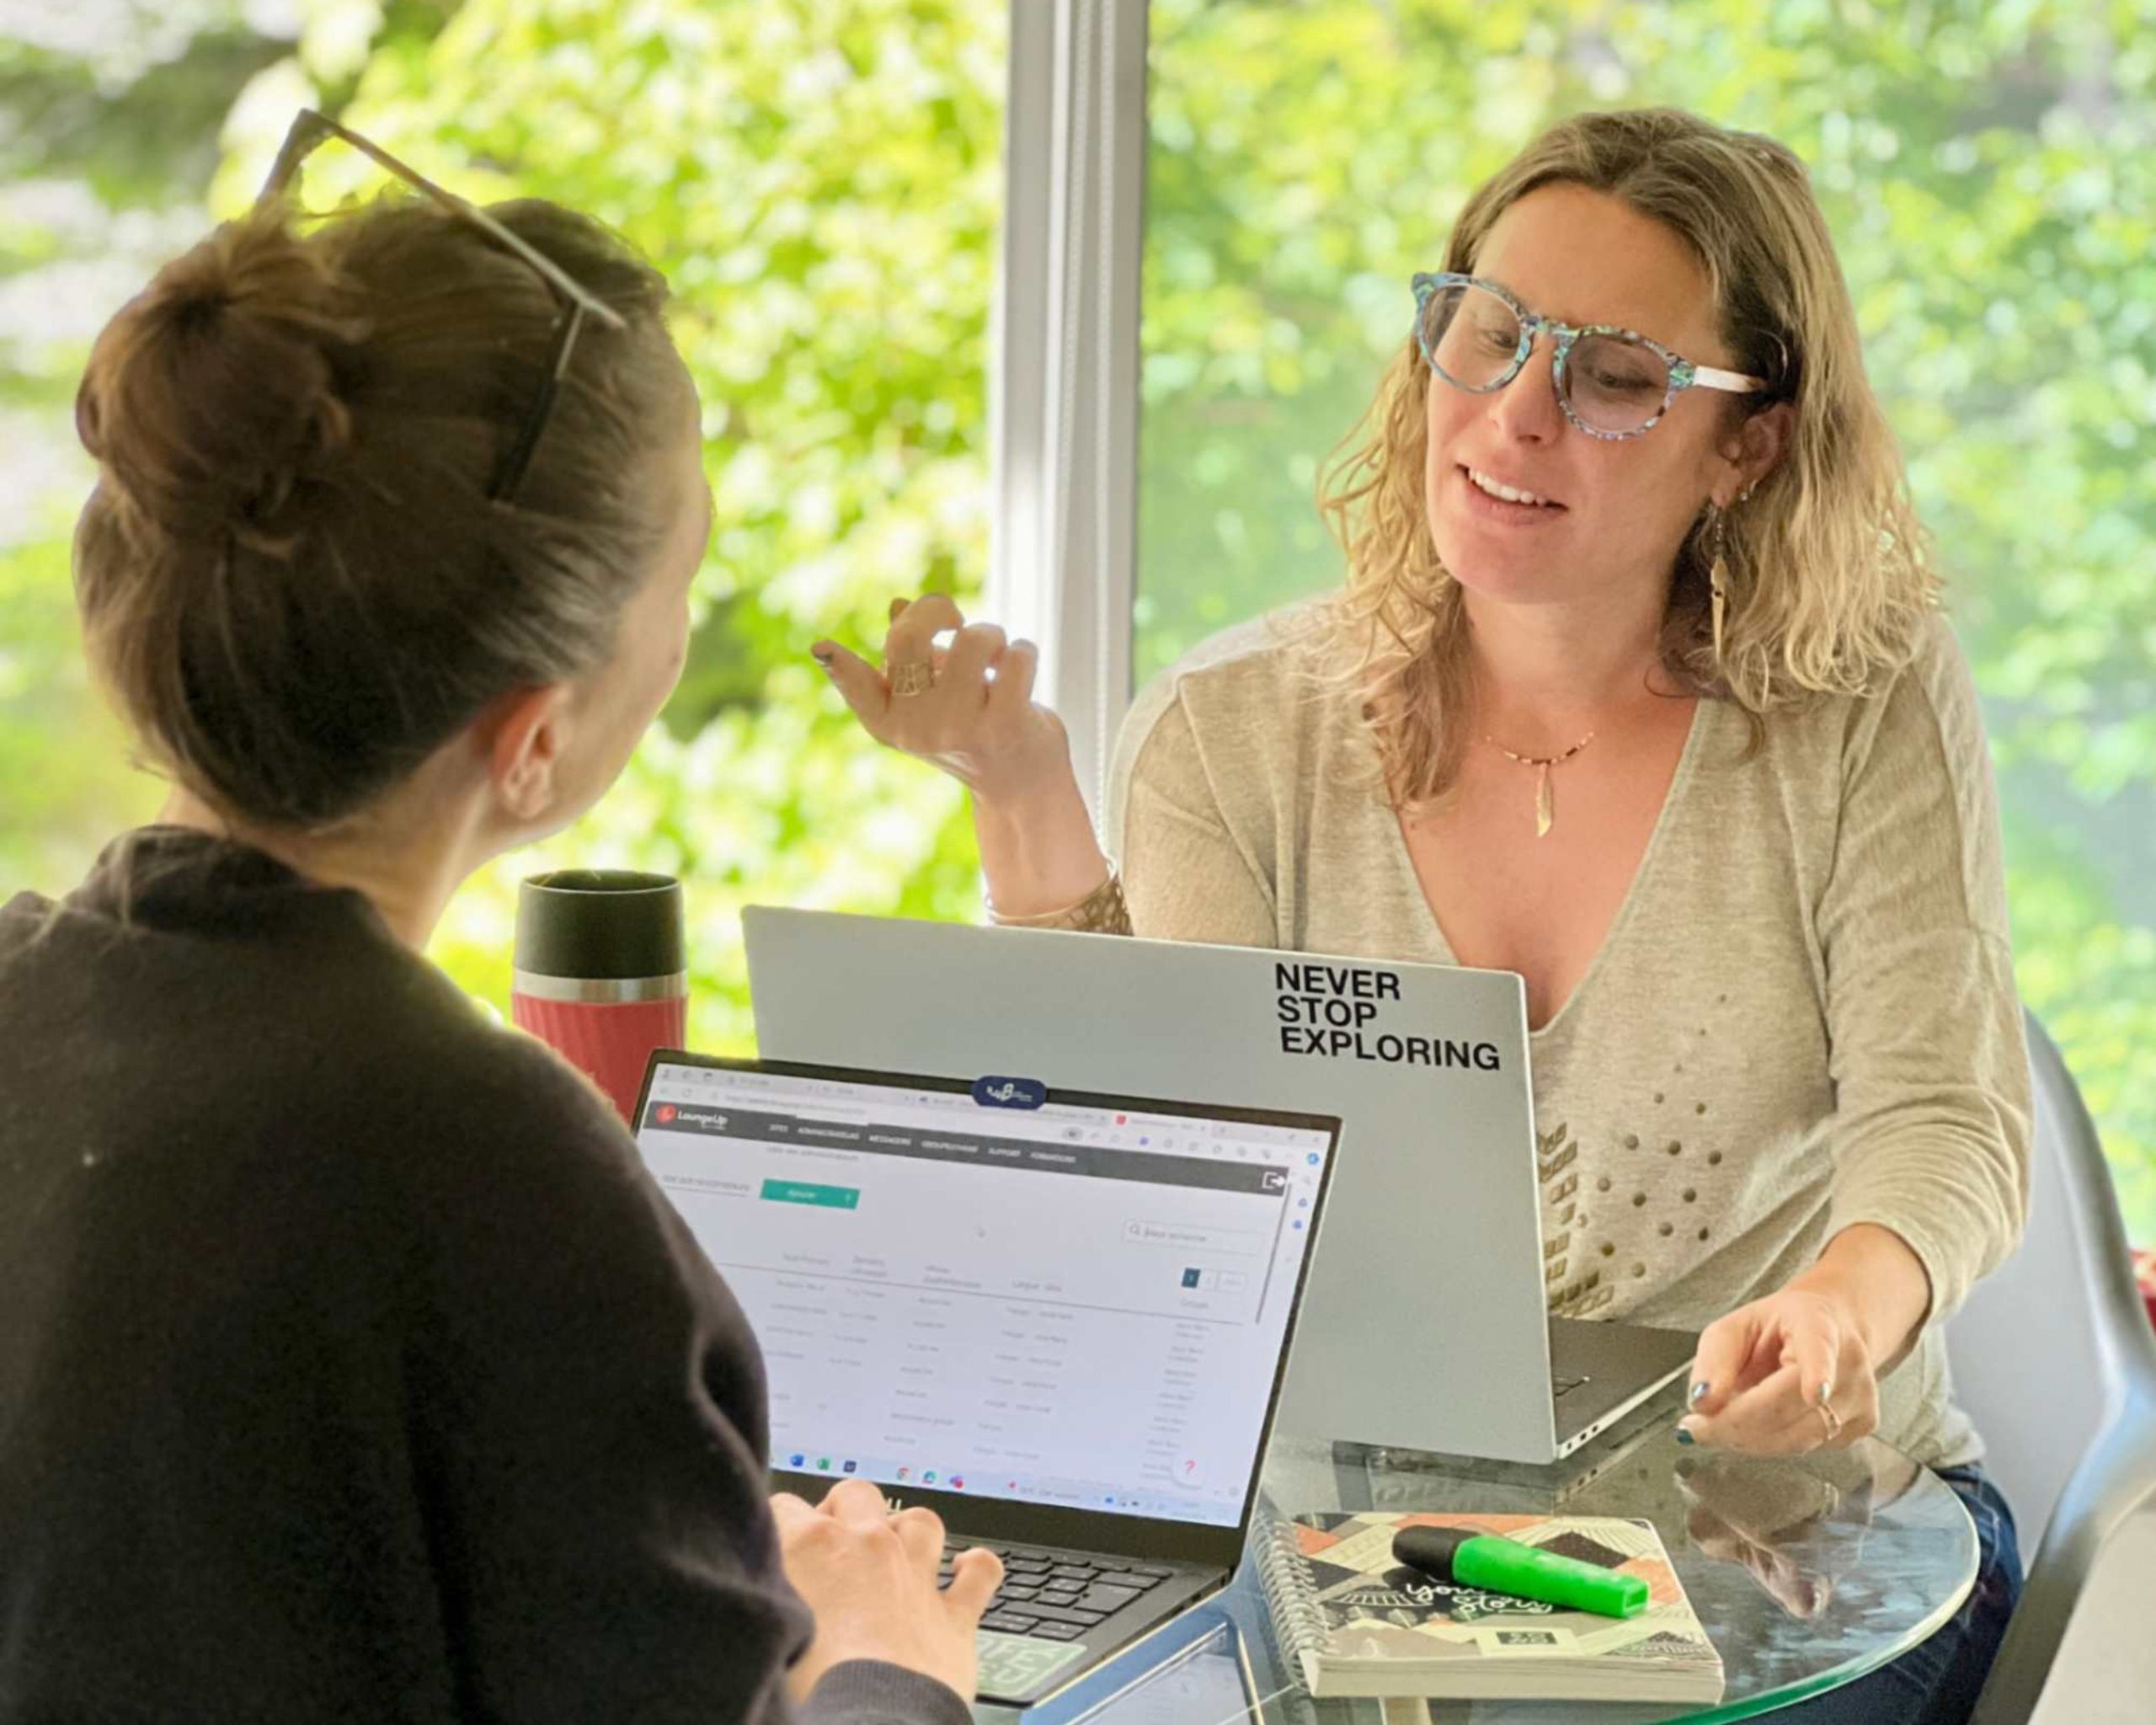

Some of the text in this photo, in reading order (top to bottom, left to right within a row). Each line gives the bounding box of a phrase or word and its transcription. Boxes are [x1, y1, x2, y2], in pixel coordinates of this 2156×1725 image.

[1275, 962, 1401, 1001] NEVER
[1277, 995, 1377, 1028] STOP
[1280, 1026, 1500, 1071] EXPLORING
